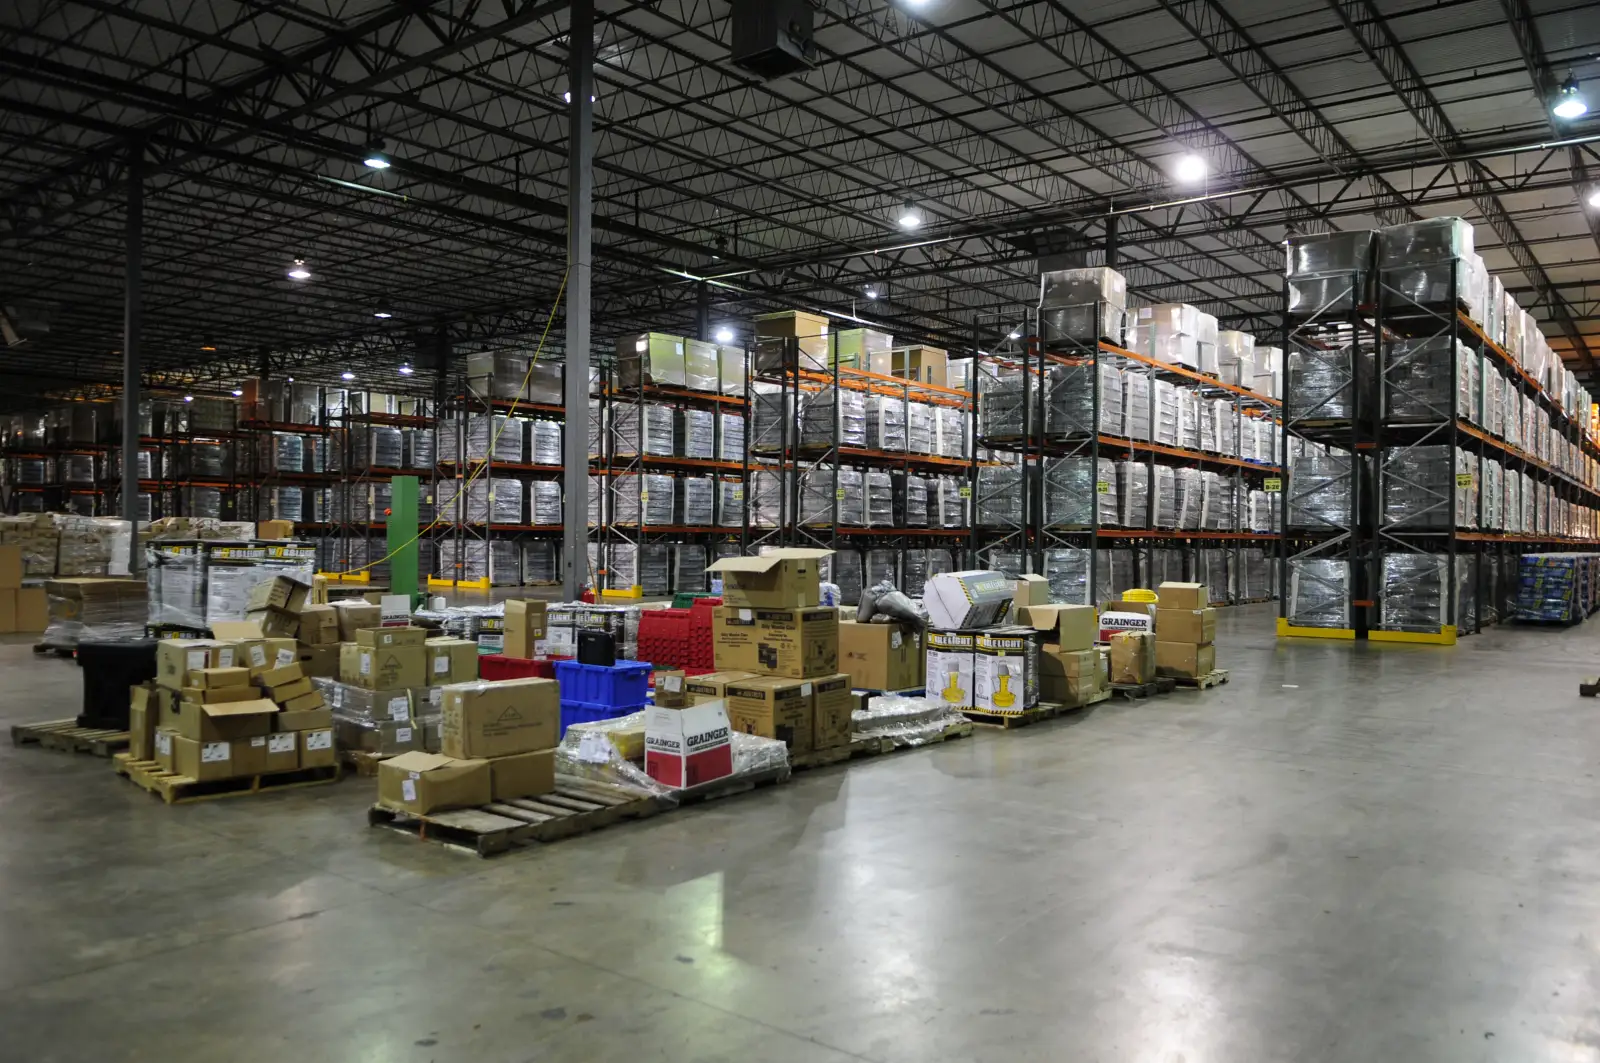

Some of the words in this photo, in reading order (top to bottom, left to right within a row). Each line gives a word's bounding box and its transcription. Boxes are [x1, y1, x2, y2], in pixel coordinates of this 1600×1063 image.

[1102, 618, 1147, 627] GRAINGER
[646, 737, 681, 749] GRAINGER
[687, 727, 729, 747] GRAINGER
